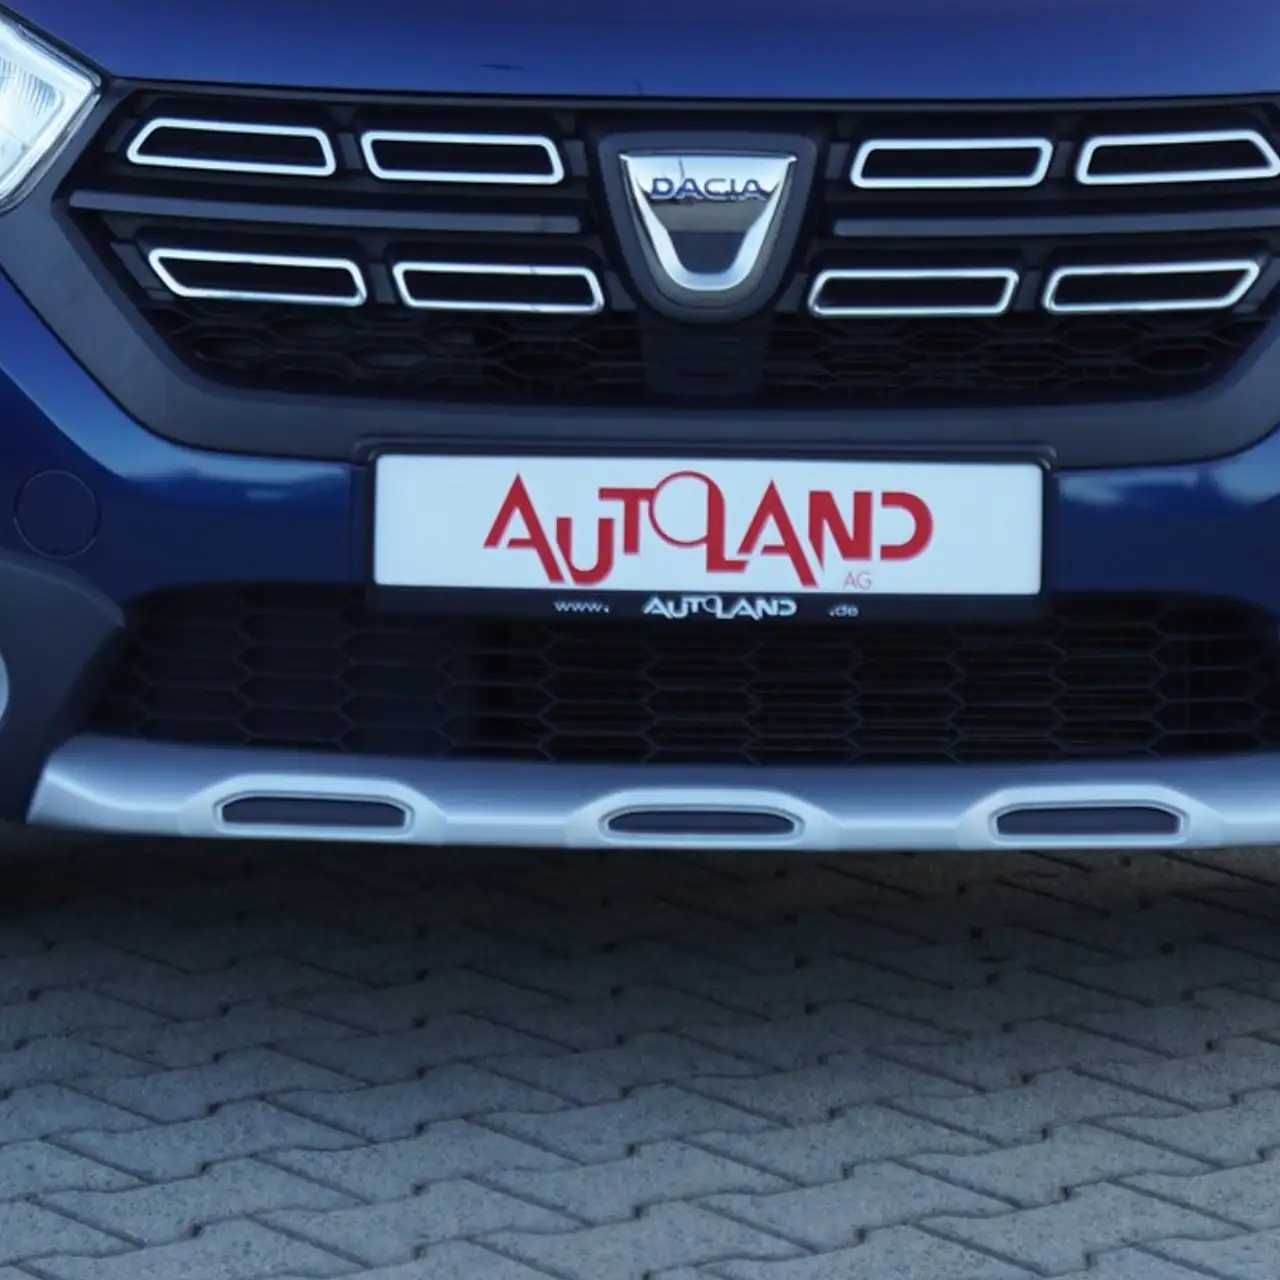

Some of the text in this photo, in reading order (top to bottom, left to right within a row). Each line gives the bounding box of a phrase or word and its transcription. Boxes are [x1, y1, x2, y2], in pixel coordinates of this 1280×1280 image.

[651, 178, 768, 201] DACIA
[483, 470, 934, 589] AUTOLAND
[843, 571, 872, 590] AG
[643, 595, 798, 620] AUTOLAND
[829, 602, 859, 618] .de
